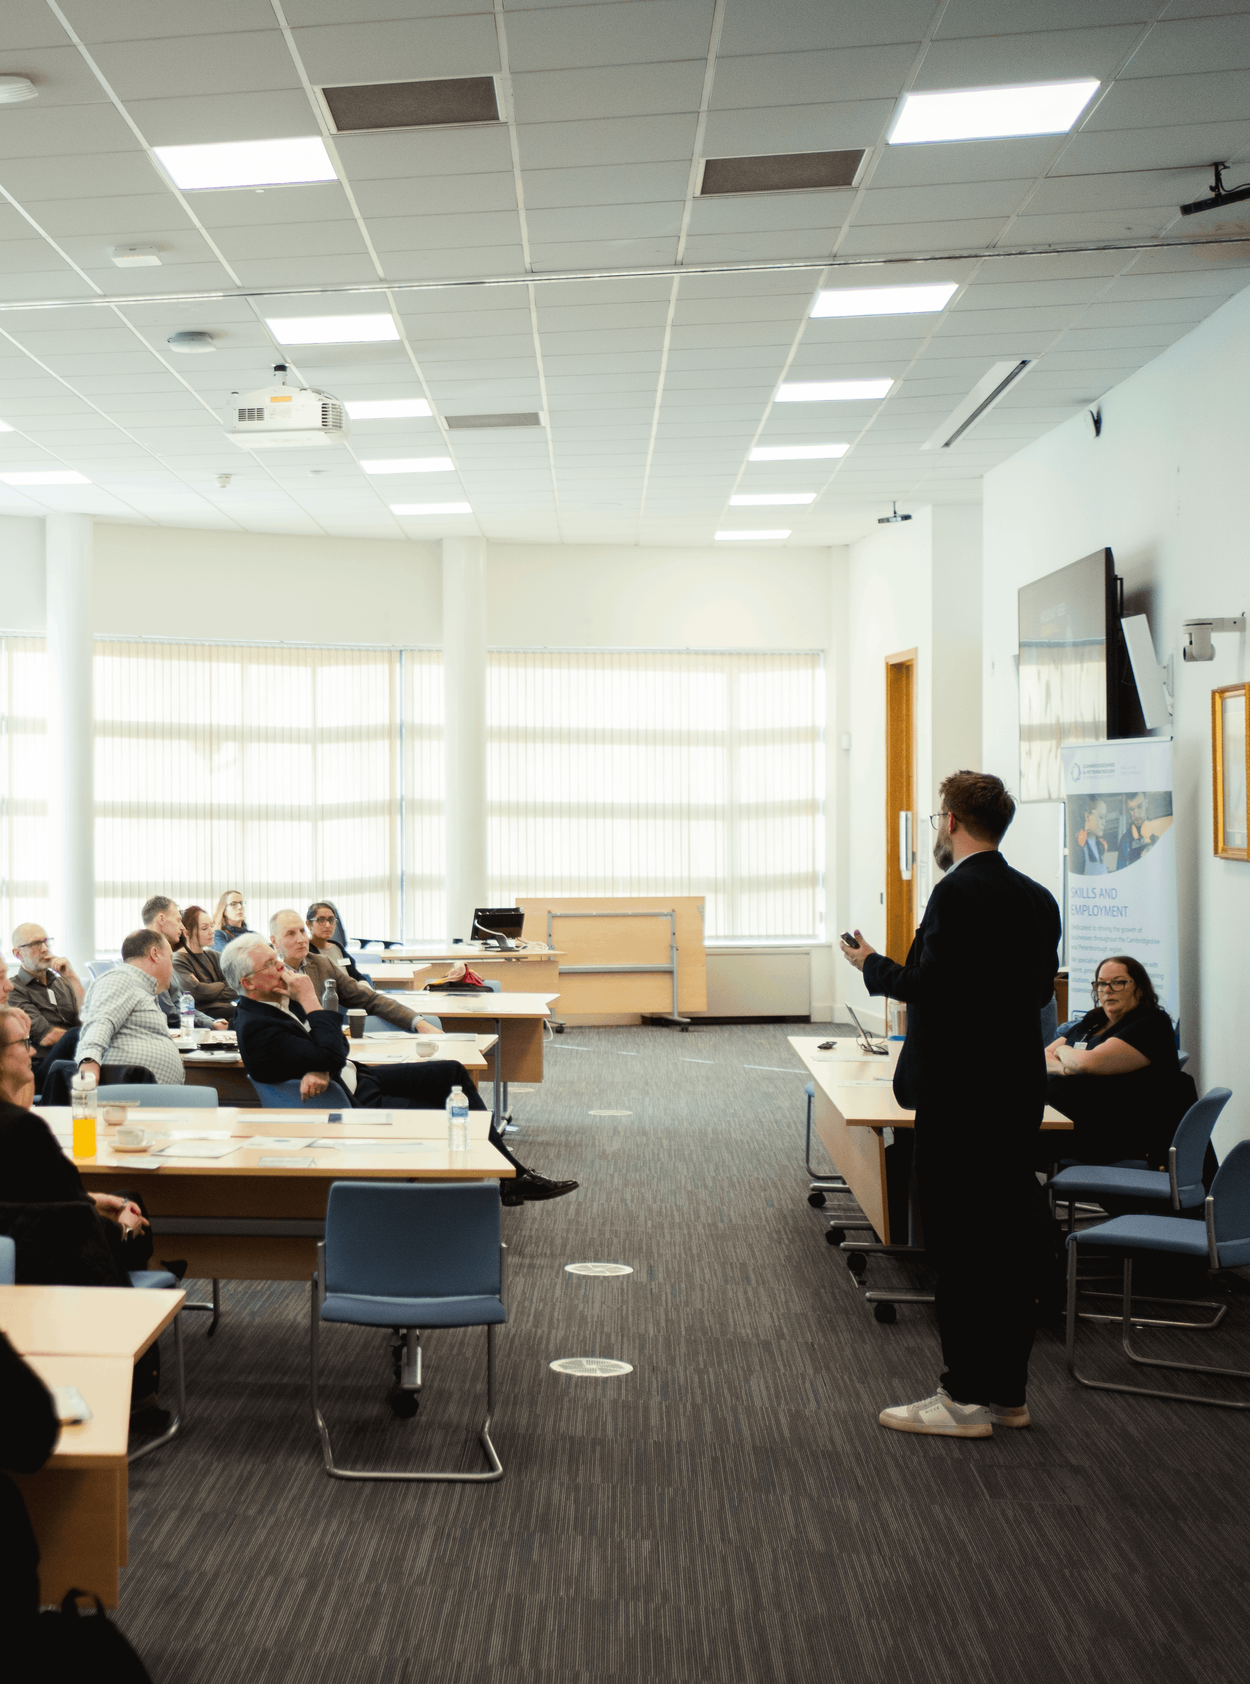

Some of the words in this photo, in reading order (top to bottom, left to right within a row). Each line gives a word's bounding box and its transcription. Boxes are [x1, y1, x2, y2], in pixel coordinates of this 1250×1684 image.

[1071, 887, 1097, 899] SKILLS
[1098, 888, 1117, 899] AND
[1071, 904, 1129, 917] EMPLOYMENT
[1126, 937, 1160, 945] Cambridgeshire
[1079, 944, 1108, 953] Peterborough
